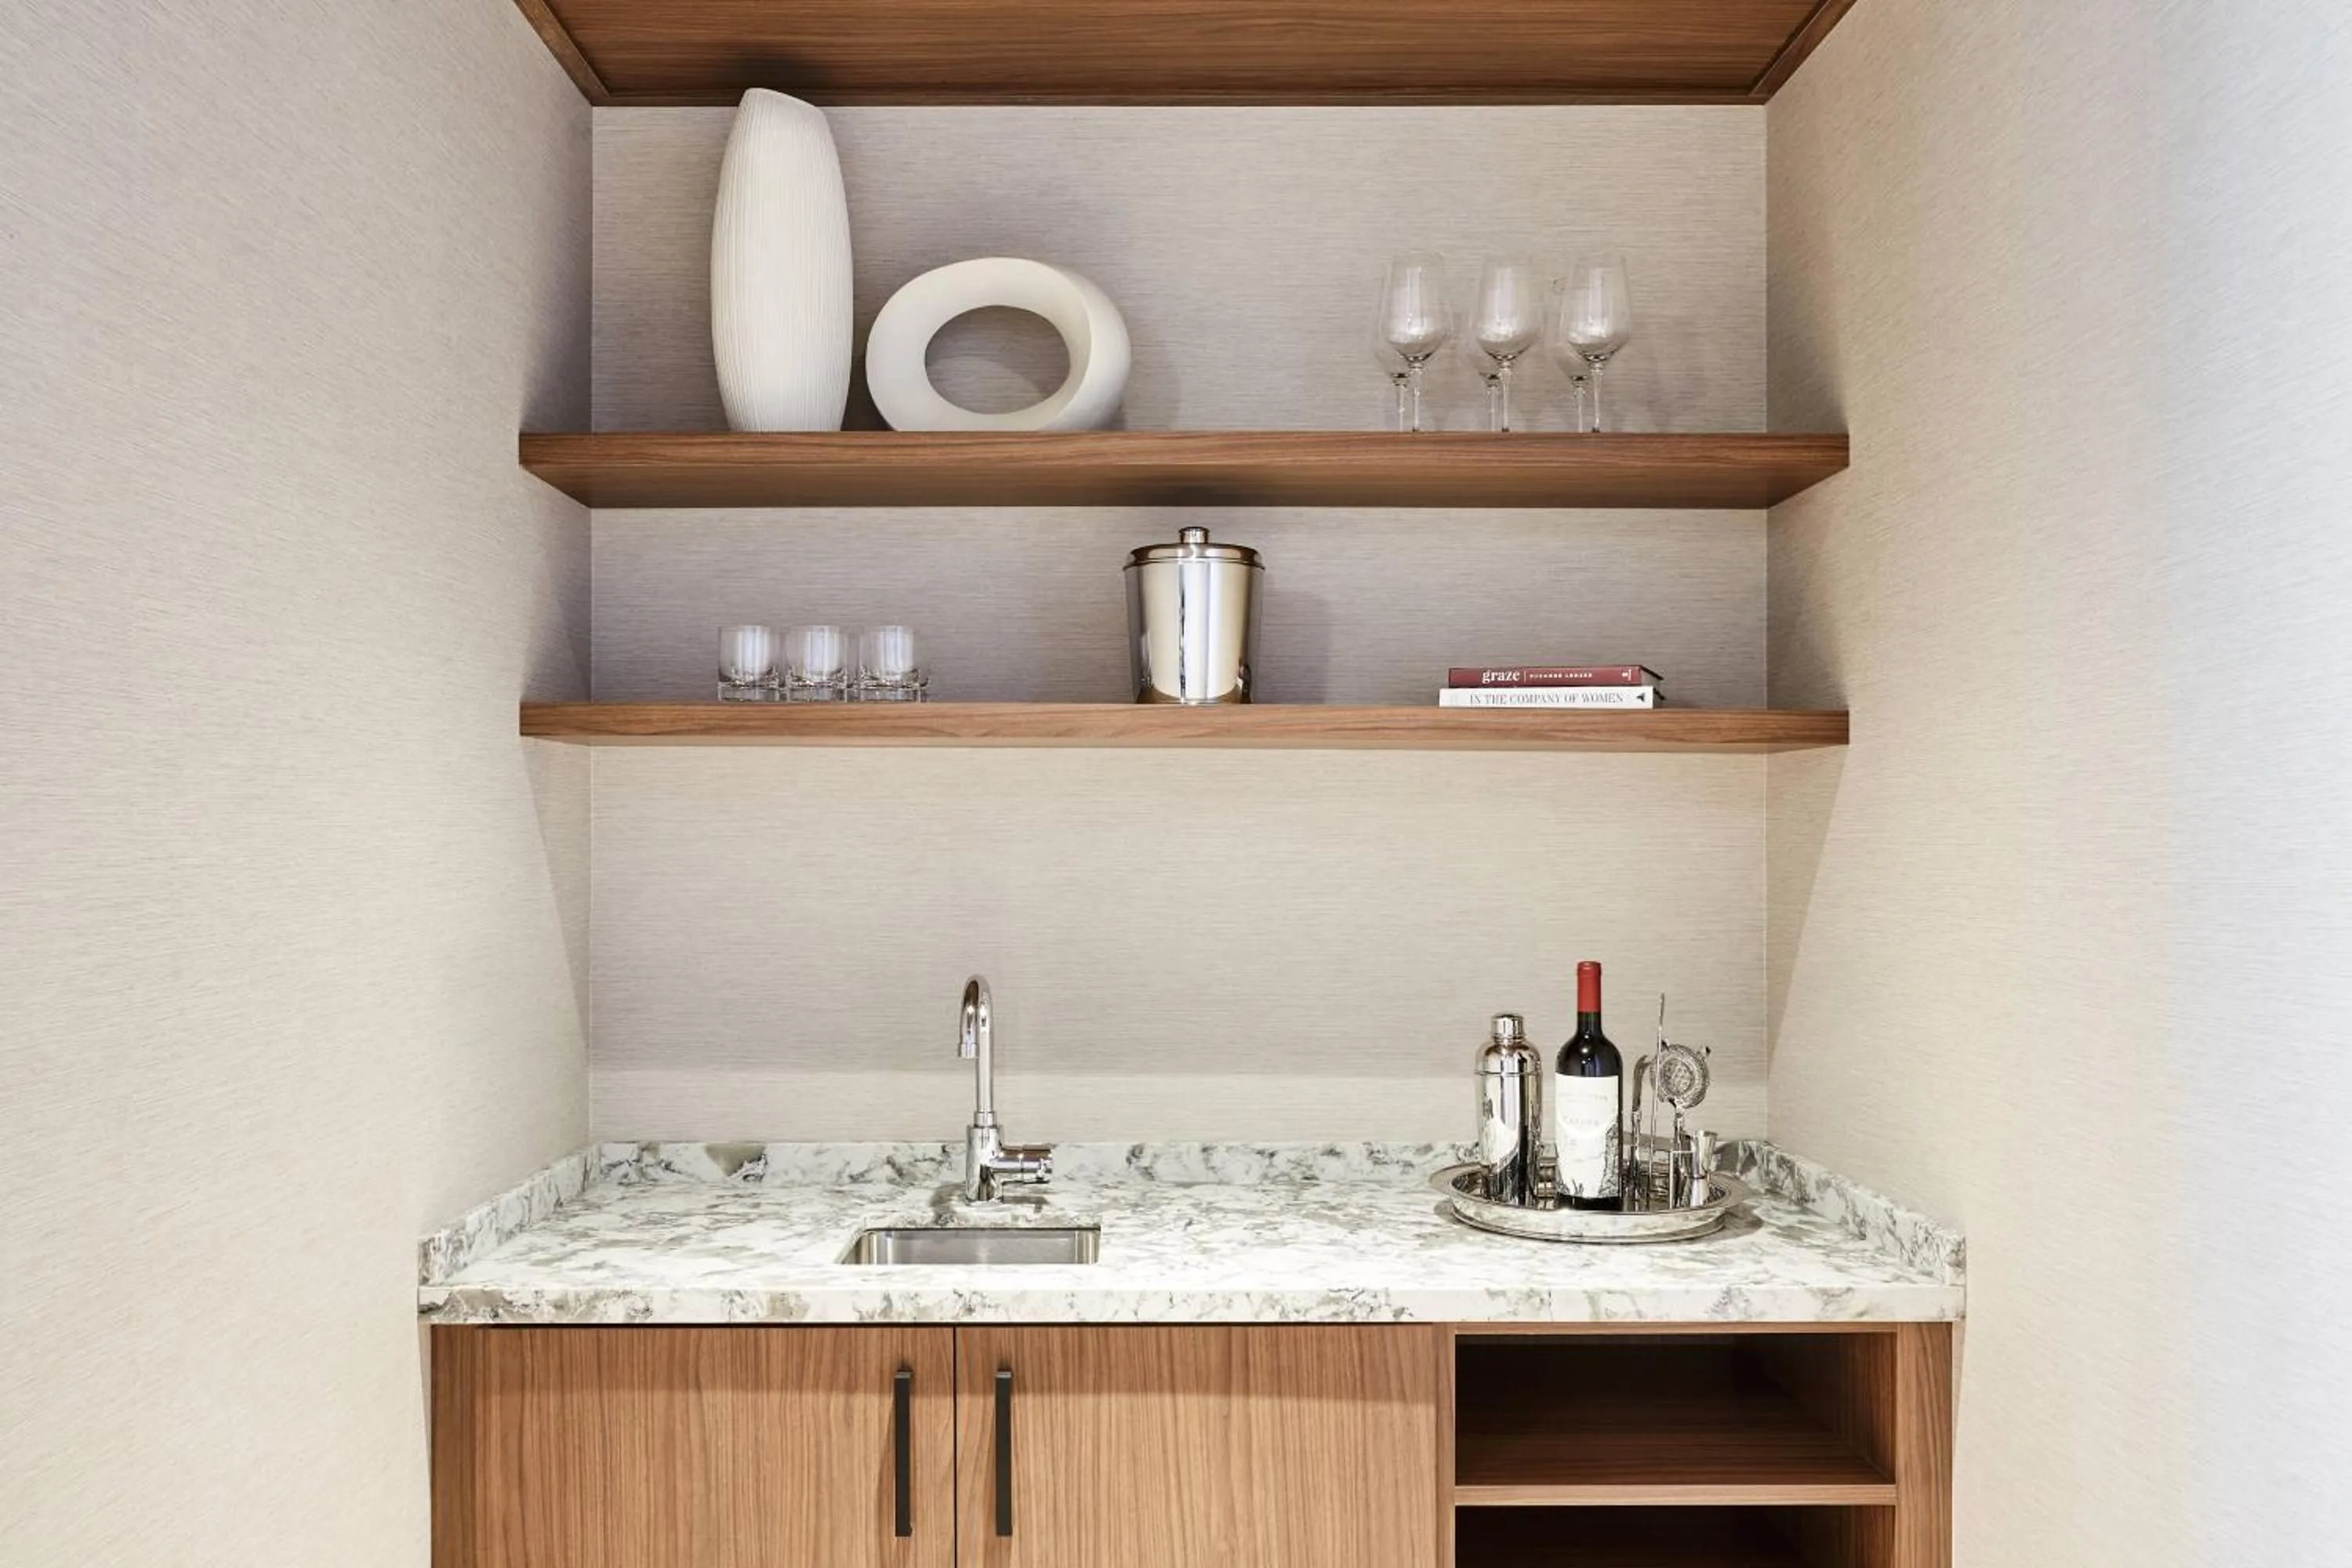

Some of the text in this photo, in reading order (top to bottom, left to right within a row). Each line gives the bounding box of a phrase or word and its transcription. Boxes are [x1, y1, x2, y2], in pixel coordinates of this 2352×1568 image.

[1482, 670, 1520, 684] graze
[1470, 693, 1624, 704] IN THE COMPANY OF WOMEN
